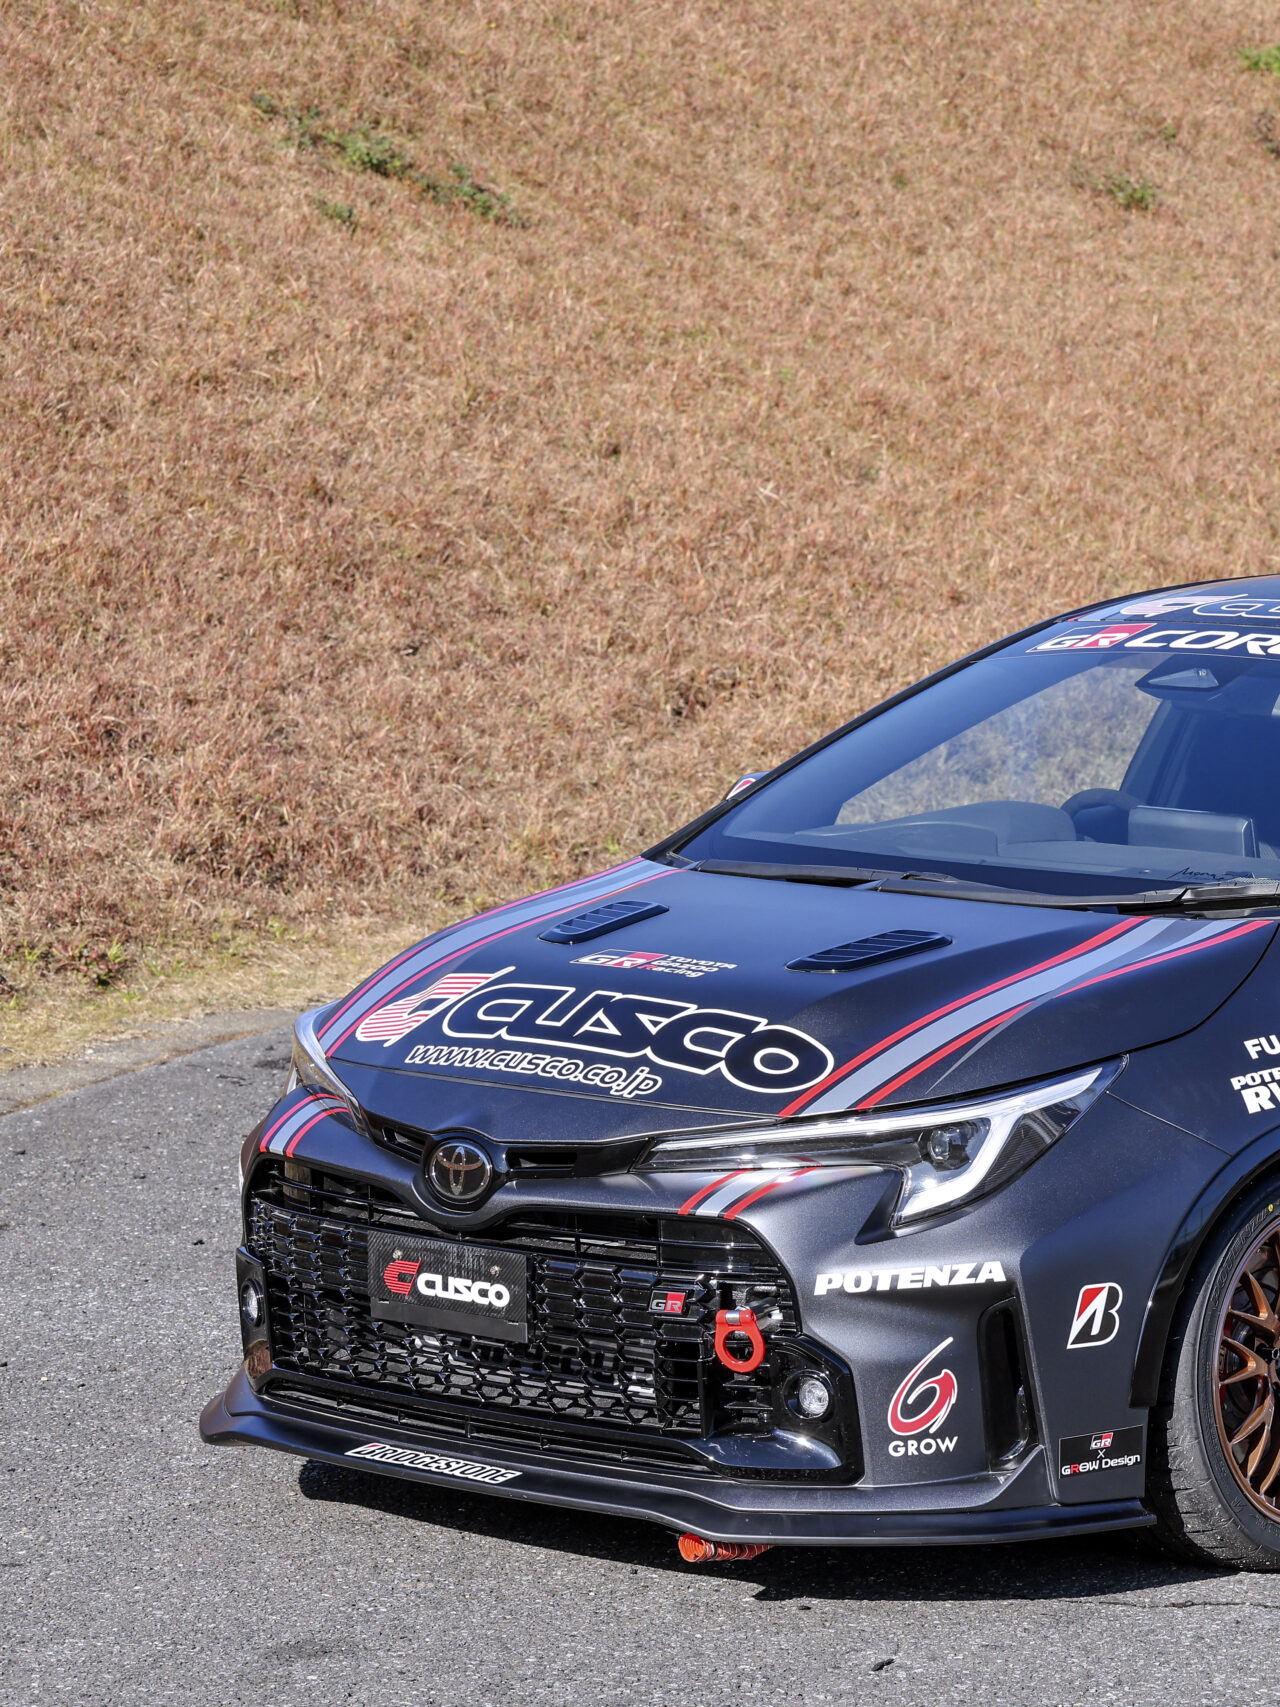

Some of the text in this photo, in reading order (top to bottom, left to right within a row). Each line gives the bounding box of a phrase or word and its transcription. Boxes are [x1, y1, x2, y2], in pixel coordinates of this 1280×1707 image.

[1036, 632, 1130, 650] GR
[637, 964, 706, 978] Racing
[651, 960, 719, 972] GAZOO
[666, 955, 738, 969] TOYOTA
[441, 982, 835, 1094] CUSCO
[404, 1045, 663, 1098] www.cusco.co.jp
[416, 1272, 510, 1308] CUSCO
[813, 1261, 1007, 1296] POTENZA
[888, 1435, 959, 1458] GROW
[345, 1443, 524, 1484] BRIDGESTONE
[1102, 1454, 1141, 1469] Design
